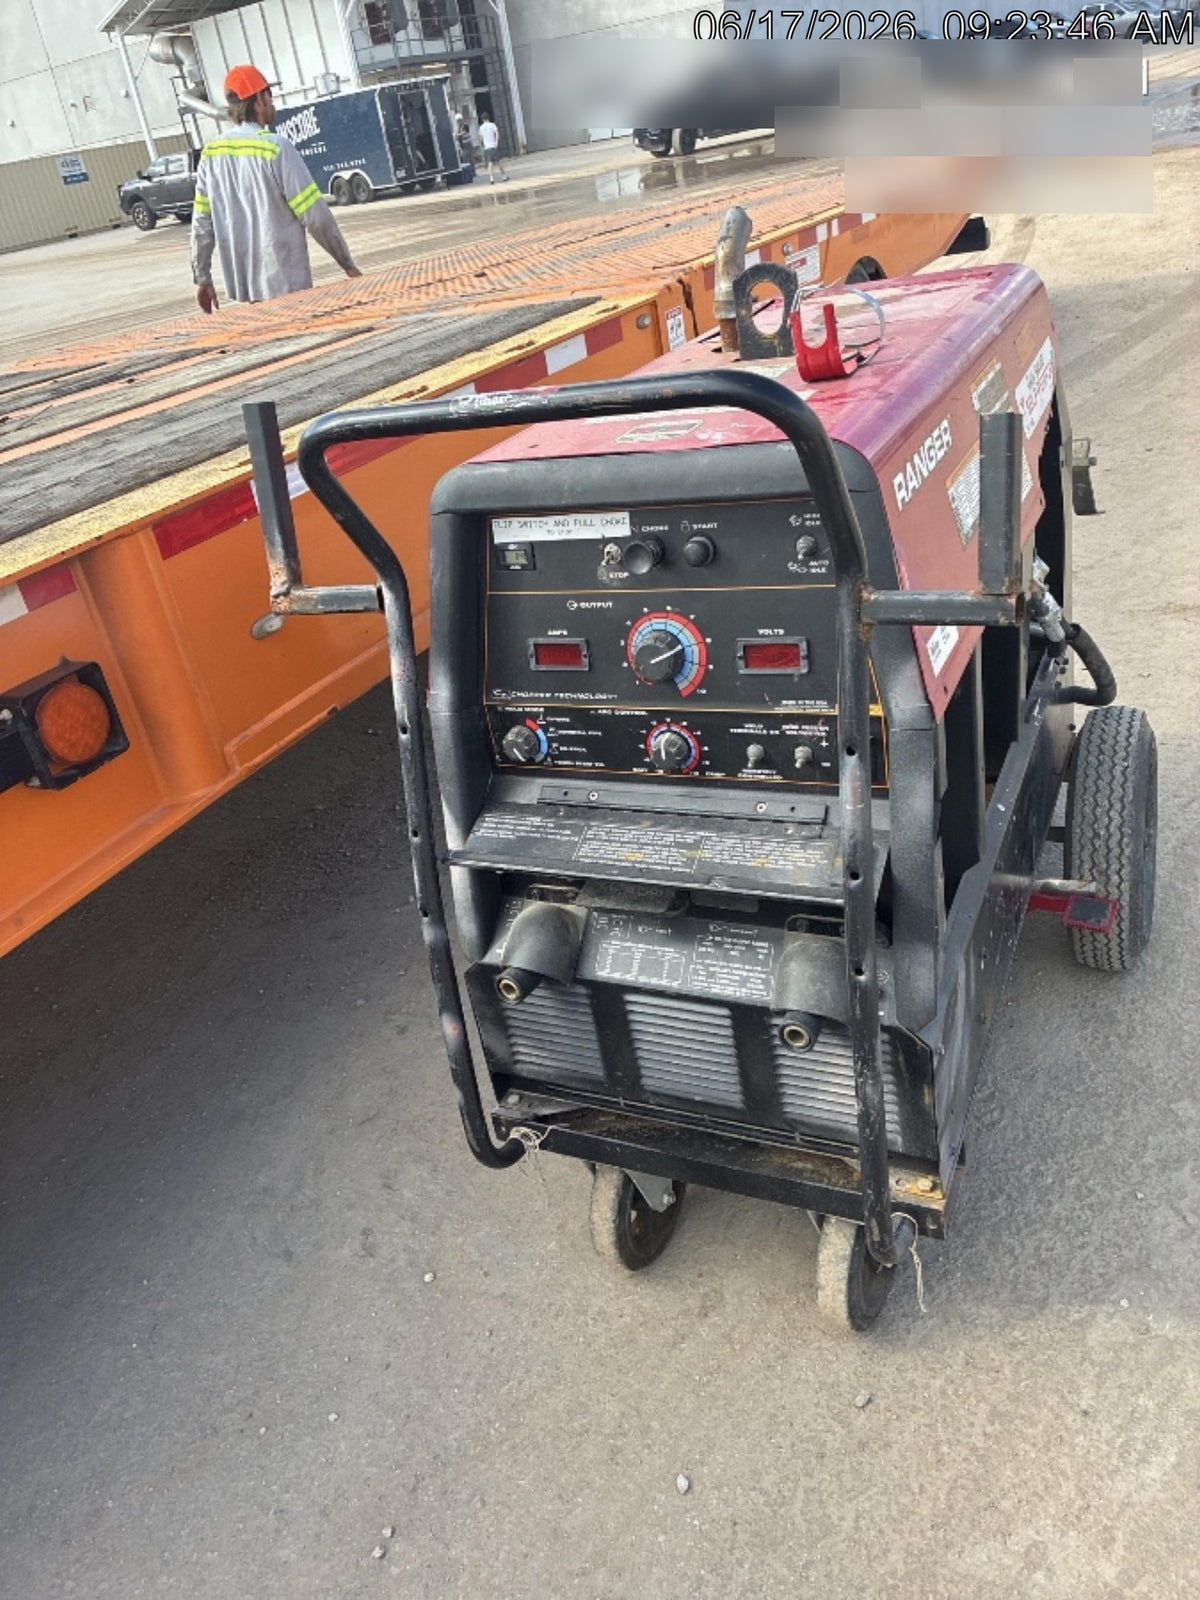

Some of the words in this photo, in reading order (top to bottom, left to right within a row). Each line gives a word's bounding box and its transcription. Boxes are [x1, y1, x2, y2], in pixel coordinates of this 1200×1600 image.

[893, 418, 952, 512] RANGER
[692, 522, 719, 531] START
[608, 571, 630, 580] STOP
[757, 628, 785, 636] VOLTS
